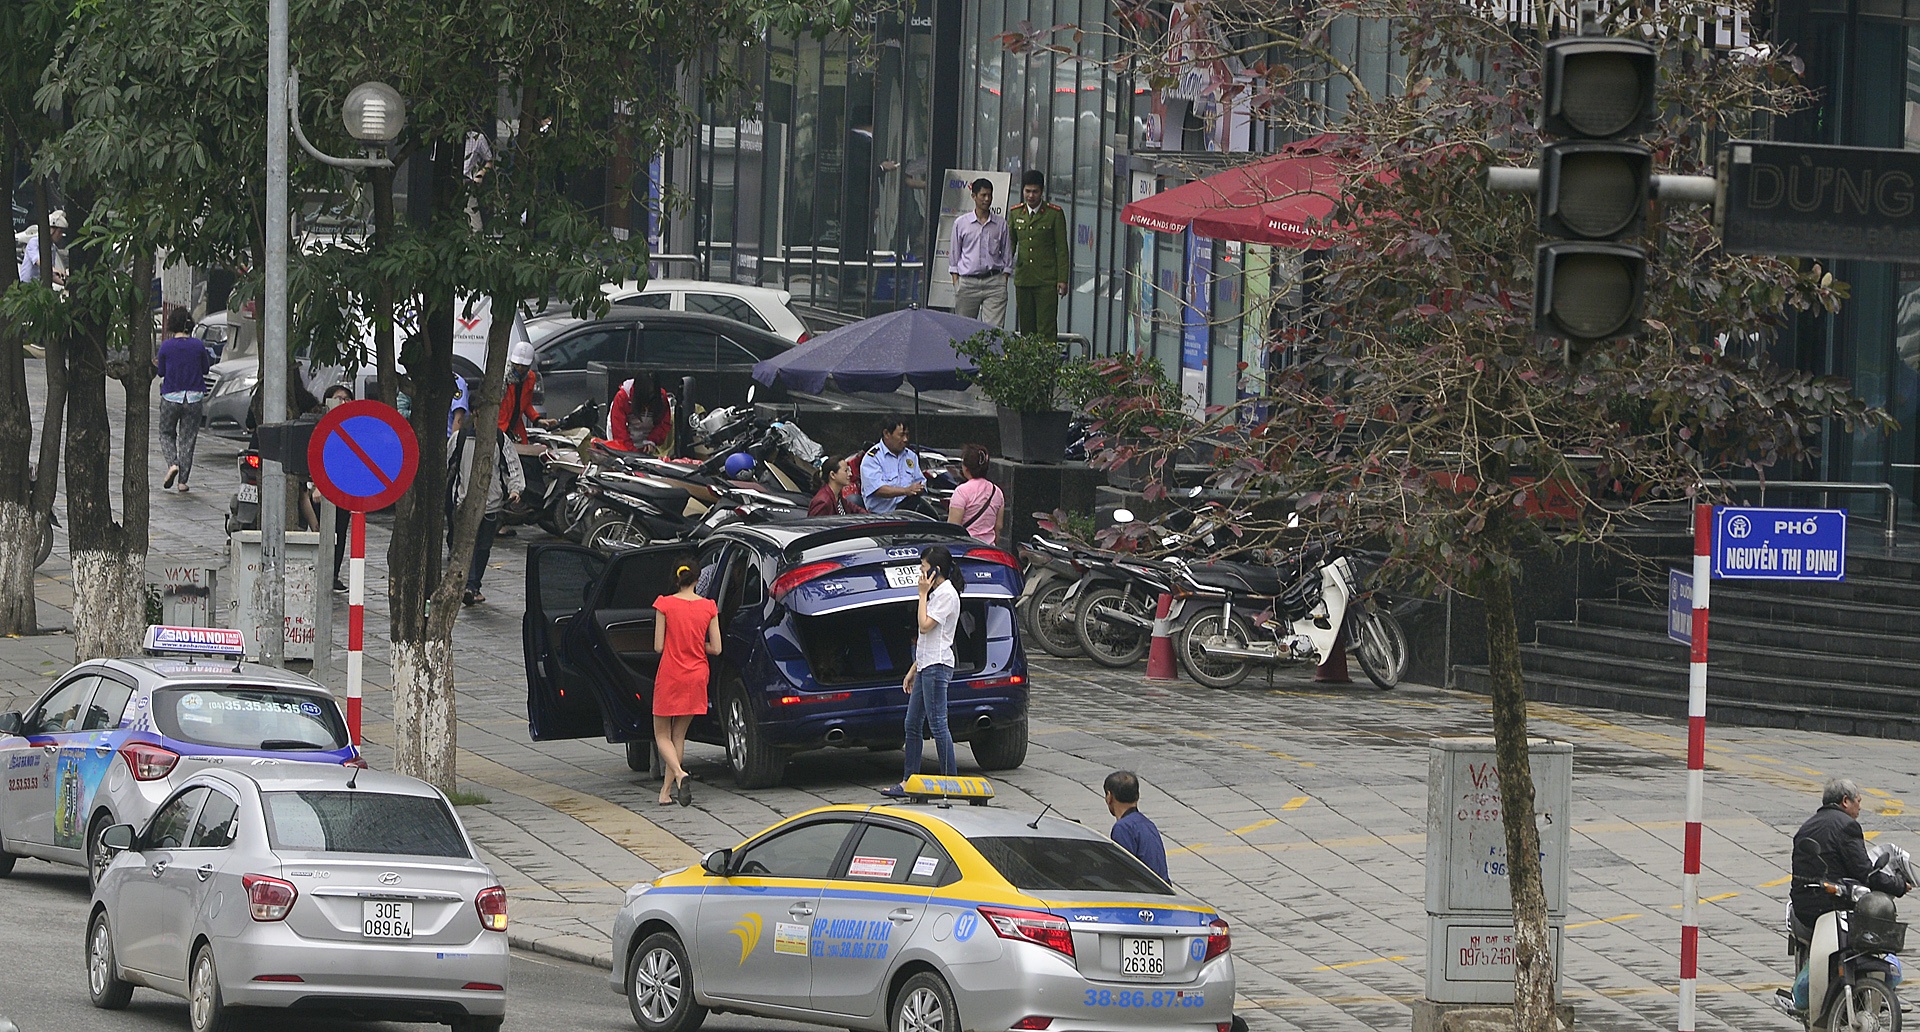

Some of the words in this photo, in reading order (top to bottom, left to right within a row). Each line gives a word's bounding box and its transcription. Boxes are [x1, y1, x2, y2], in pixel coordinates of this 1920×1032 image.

[1748, 154, 1915, 217] DỪNG
[1774, 515, 1818, 535] PHỐ
[1726, 540, 1778, 570] NGUYỄN
[1781, 549, 1802, 574] THỊ
[1805, 549, 1838, 574] ĐỊNH
[895, 566, 919, 577] 30E
[166, 628, 189, 643] SAO
[190, 631, 226, 644] HANOI
[374, 903, 402, 919] 30E
[1074, 914, 1099, 922] VIOS
[364, 920, 411, 937] 089.64
[811, 918, 867, 940] HP-NOIBAI
[867, 920, 893, 941] TAXI
[956, 915, 976, 938] 97
[811, 940, 825, 957] TEL
[1133, 940, 1155, 956] 30E
[1192, 942, 1205, 958] 97
[1124, 957, 1163, 974] 263.86
[1083, 988, 1205, 1009] 38.86.87.88
